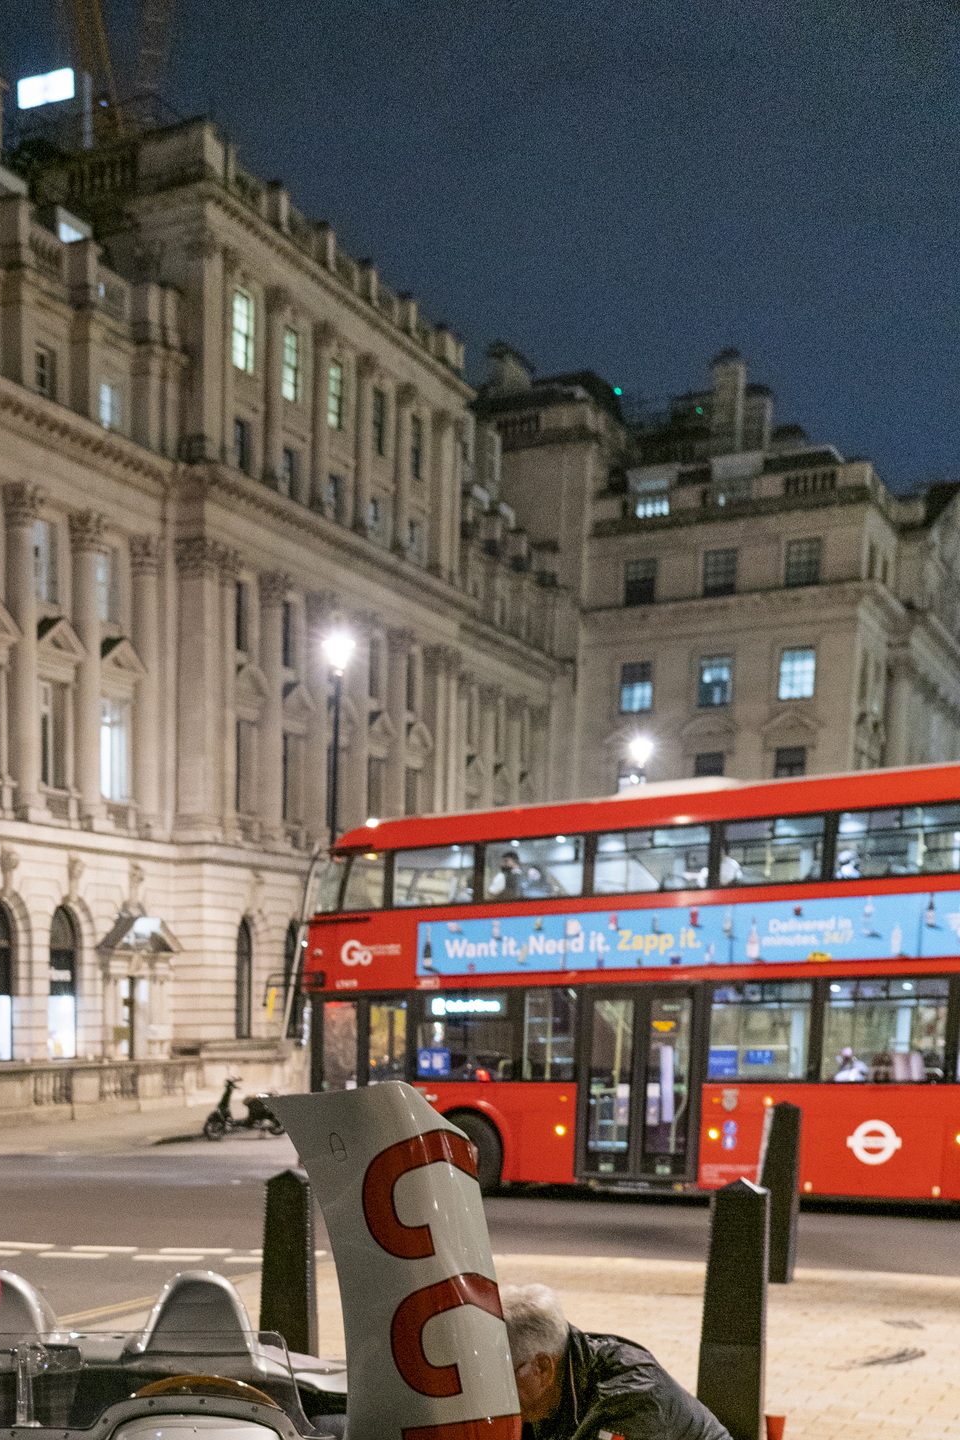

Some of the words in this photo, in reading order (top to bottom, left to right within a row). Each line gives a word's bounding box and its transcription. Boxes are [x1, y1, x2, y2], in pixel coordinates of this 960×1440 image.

[341, 939, 373, 966] Go
[444, 937, 497, 959] Want
[528, 932, 585, 955] Need
[589, 930, 611, 953] it.
[617, 929, 674, 956] Zapp
[680, 926, 702, 949] it.
